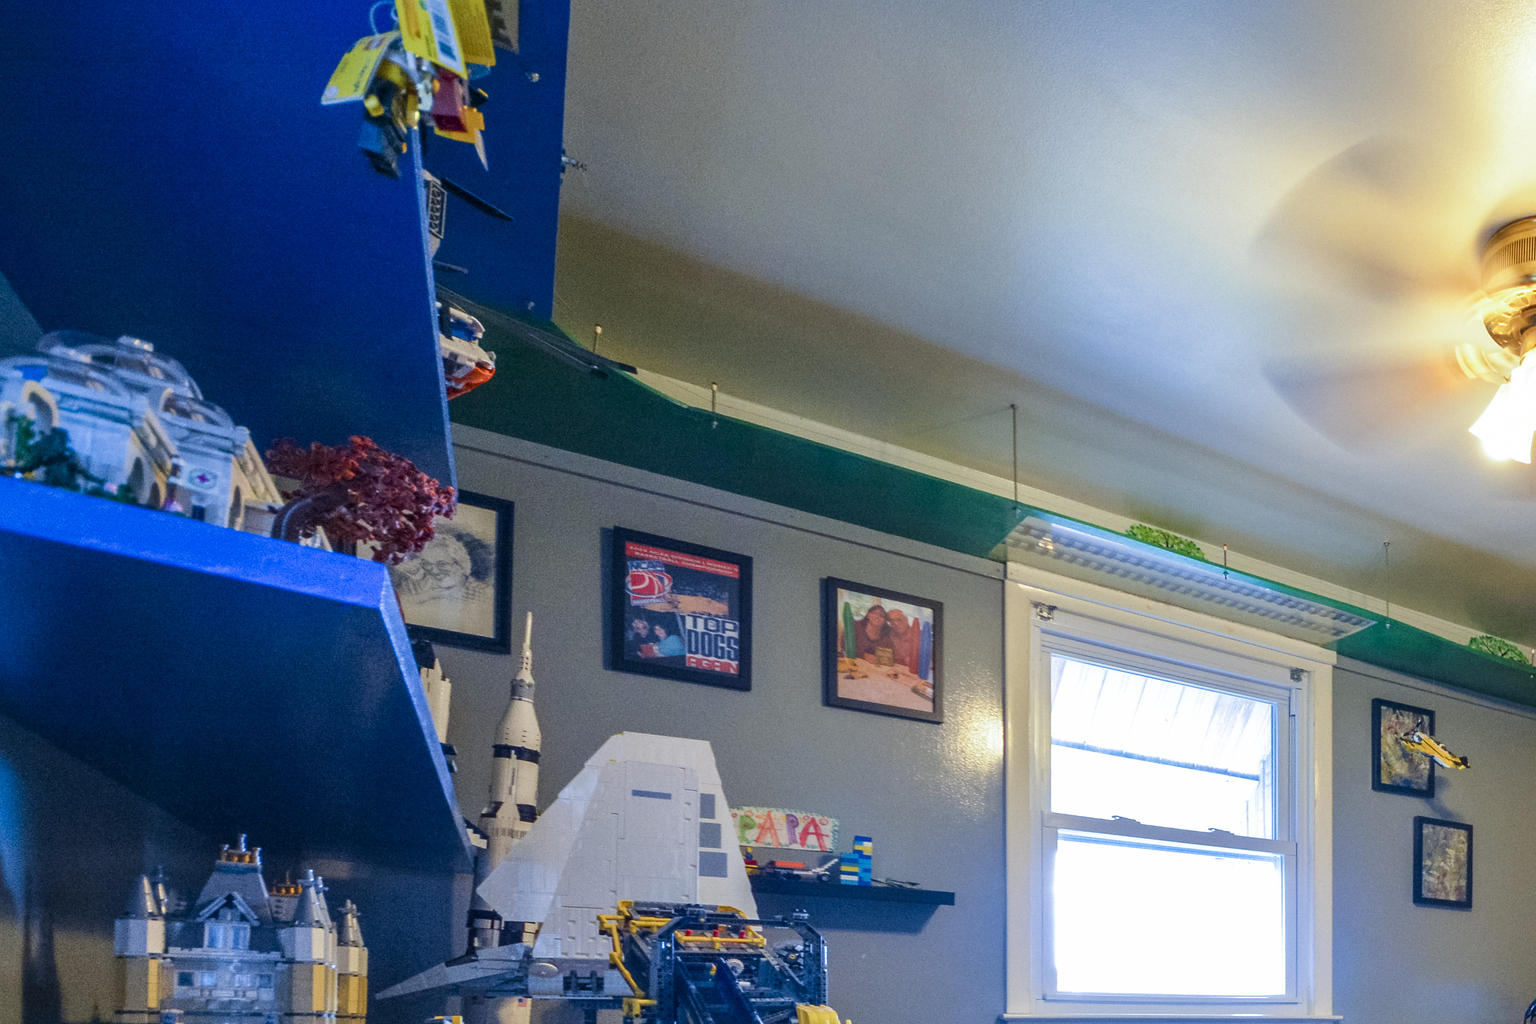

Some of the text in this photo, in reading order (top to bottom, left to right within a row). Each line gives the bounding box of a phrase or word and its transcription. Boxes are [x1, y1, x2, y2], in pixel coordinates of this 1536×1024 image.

[685, 614, 739, 637] TOP
[686, 629, 739, 662] DOGS
[739, 811, 830, 852] PAPA
